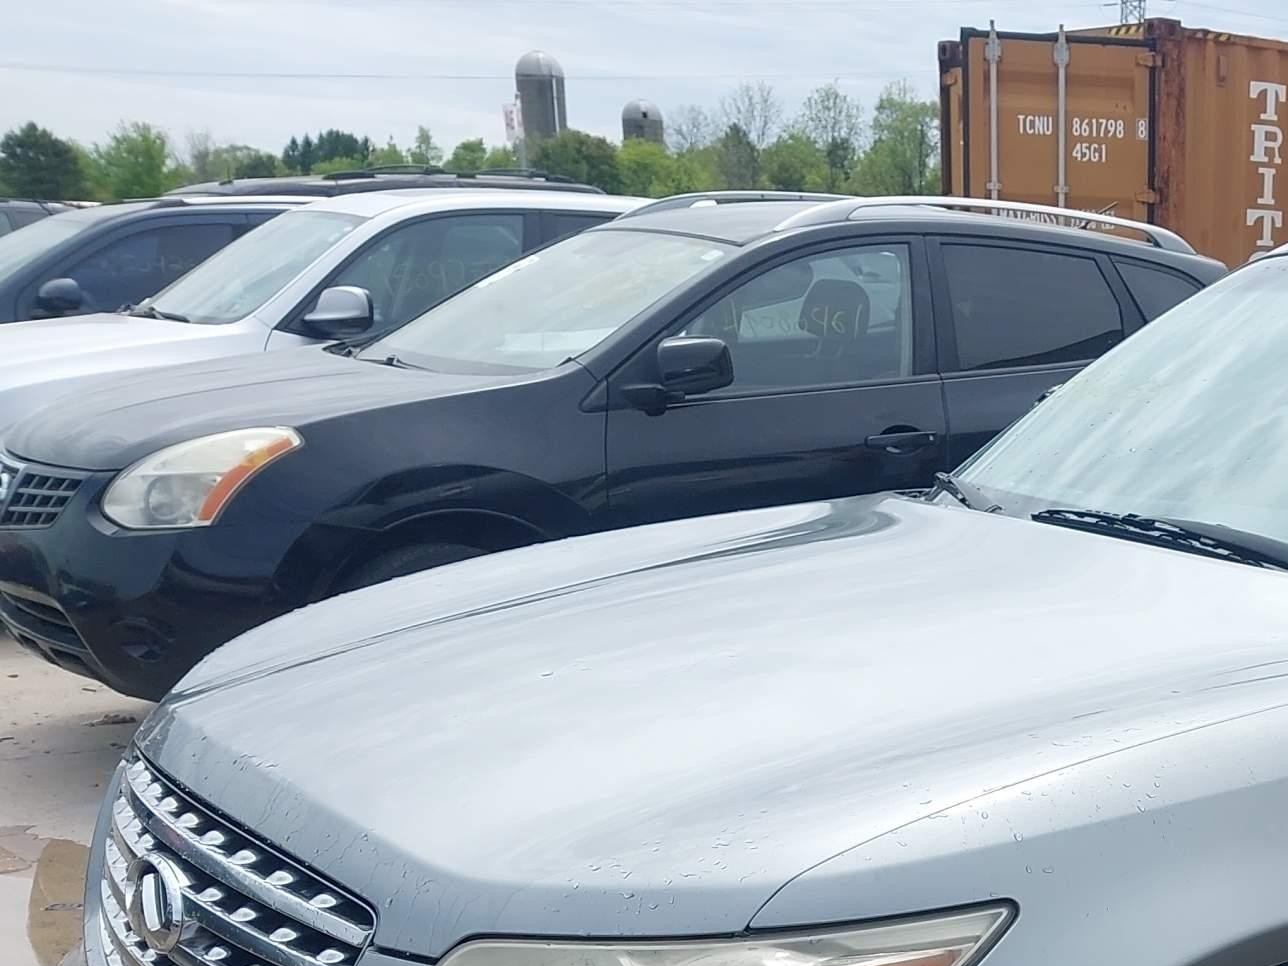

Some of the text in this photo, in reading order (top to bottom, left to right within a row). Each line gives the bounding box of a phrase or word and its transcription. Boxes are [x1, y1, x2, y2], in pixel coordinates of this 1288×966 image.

[1017, 115, 1146, 138] TCNU 861798 8
[1072, 143, 1106, 162] 45G1
